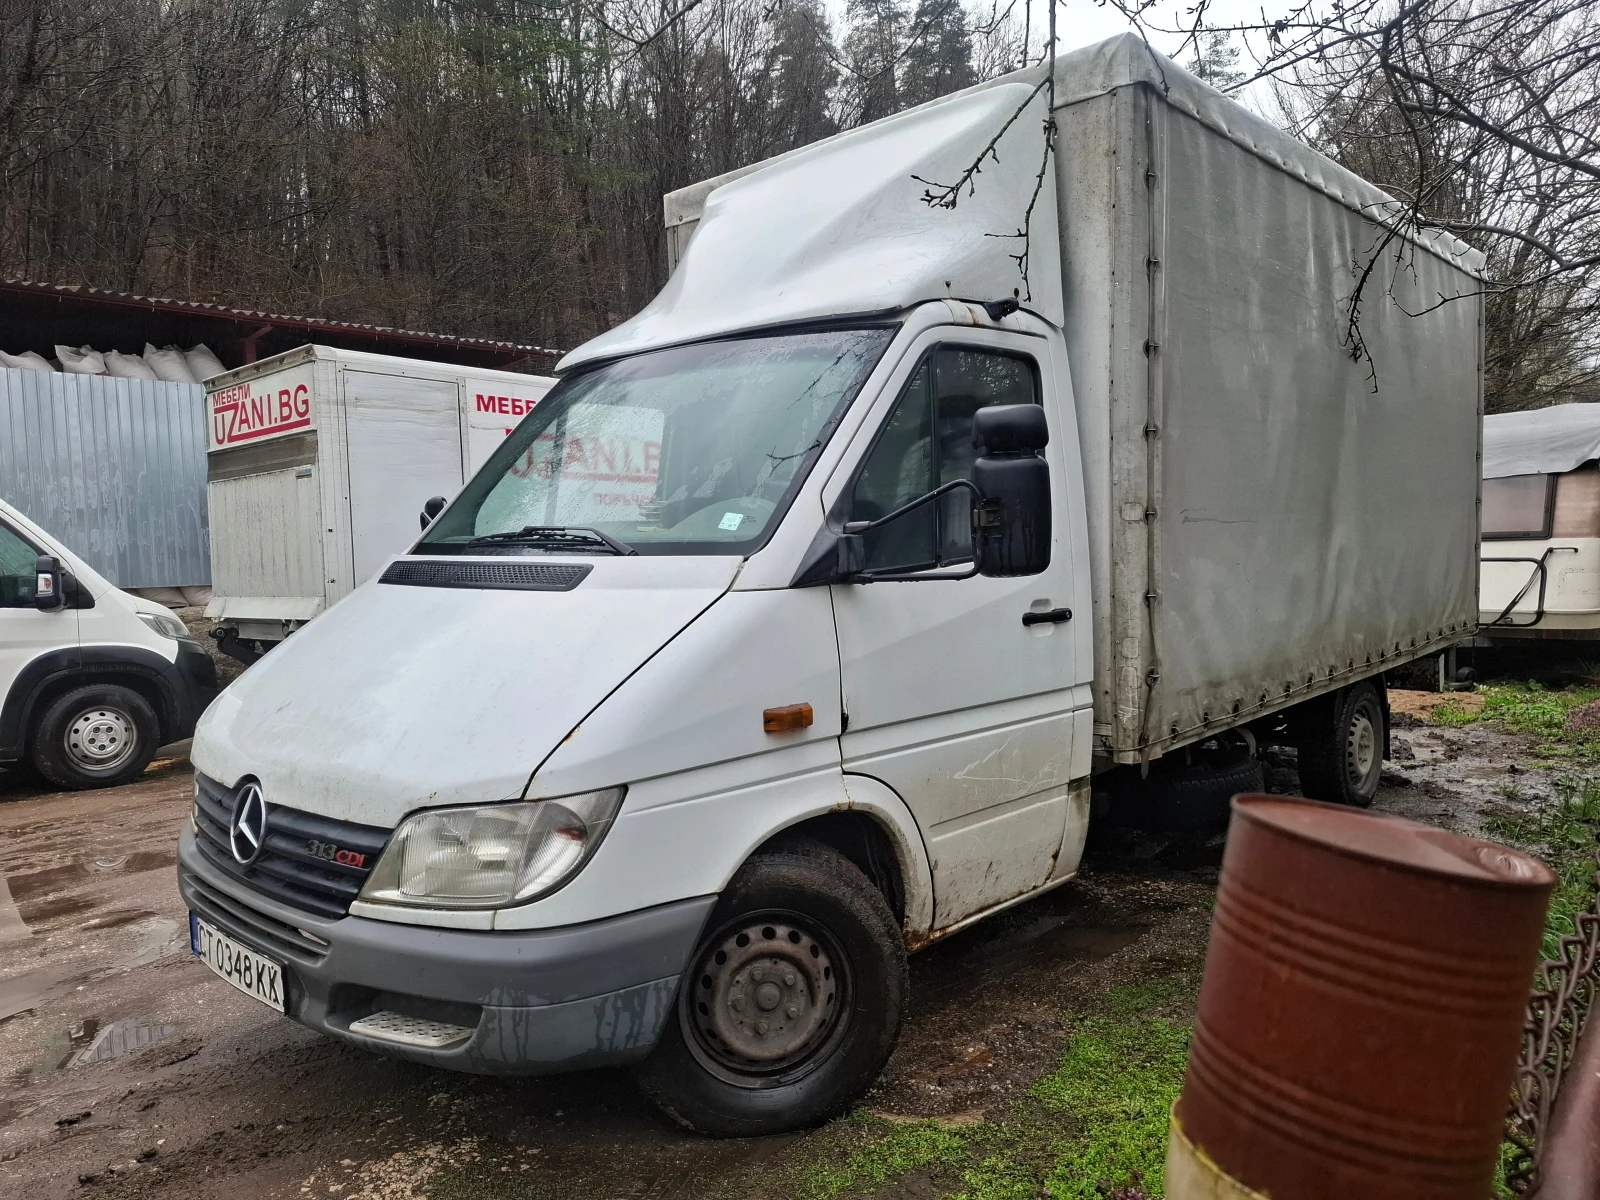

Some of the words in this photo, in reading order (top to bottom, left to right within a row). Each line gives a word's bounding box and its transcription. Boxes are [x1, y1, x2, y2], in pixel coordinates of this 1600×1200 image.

[212, 383, 251, 407] МЕБЕЛИ
[213, 384, 310, 445] UZANI.BG
[199, 924, 214, 963] CT
[216, 937, 253, 989] 0348
[255, 959, 281, 1005] KX
